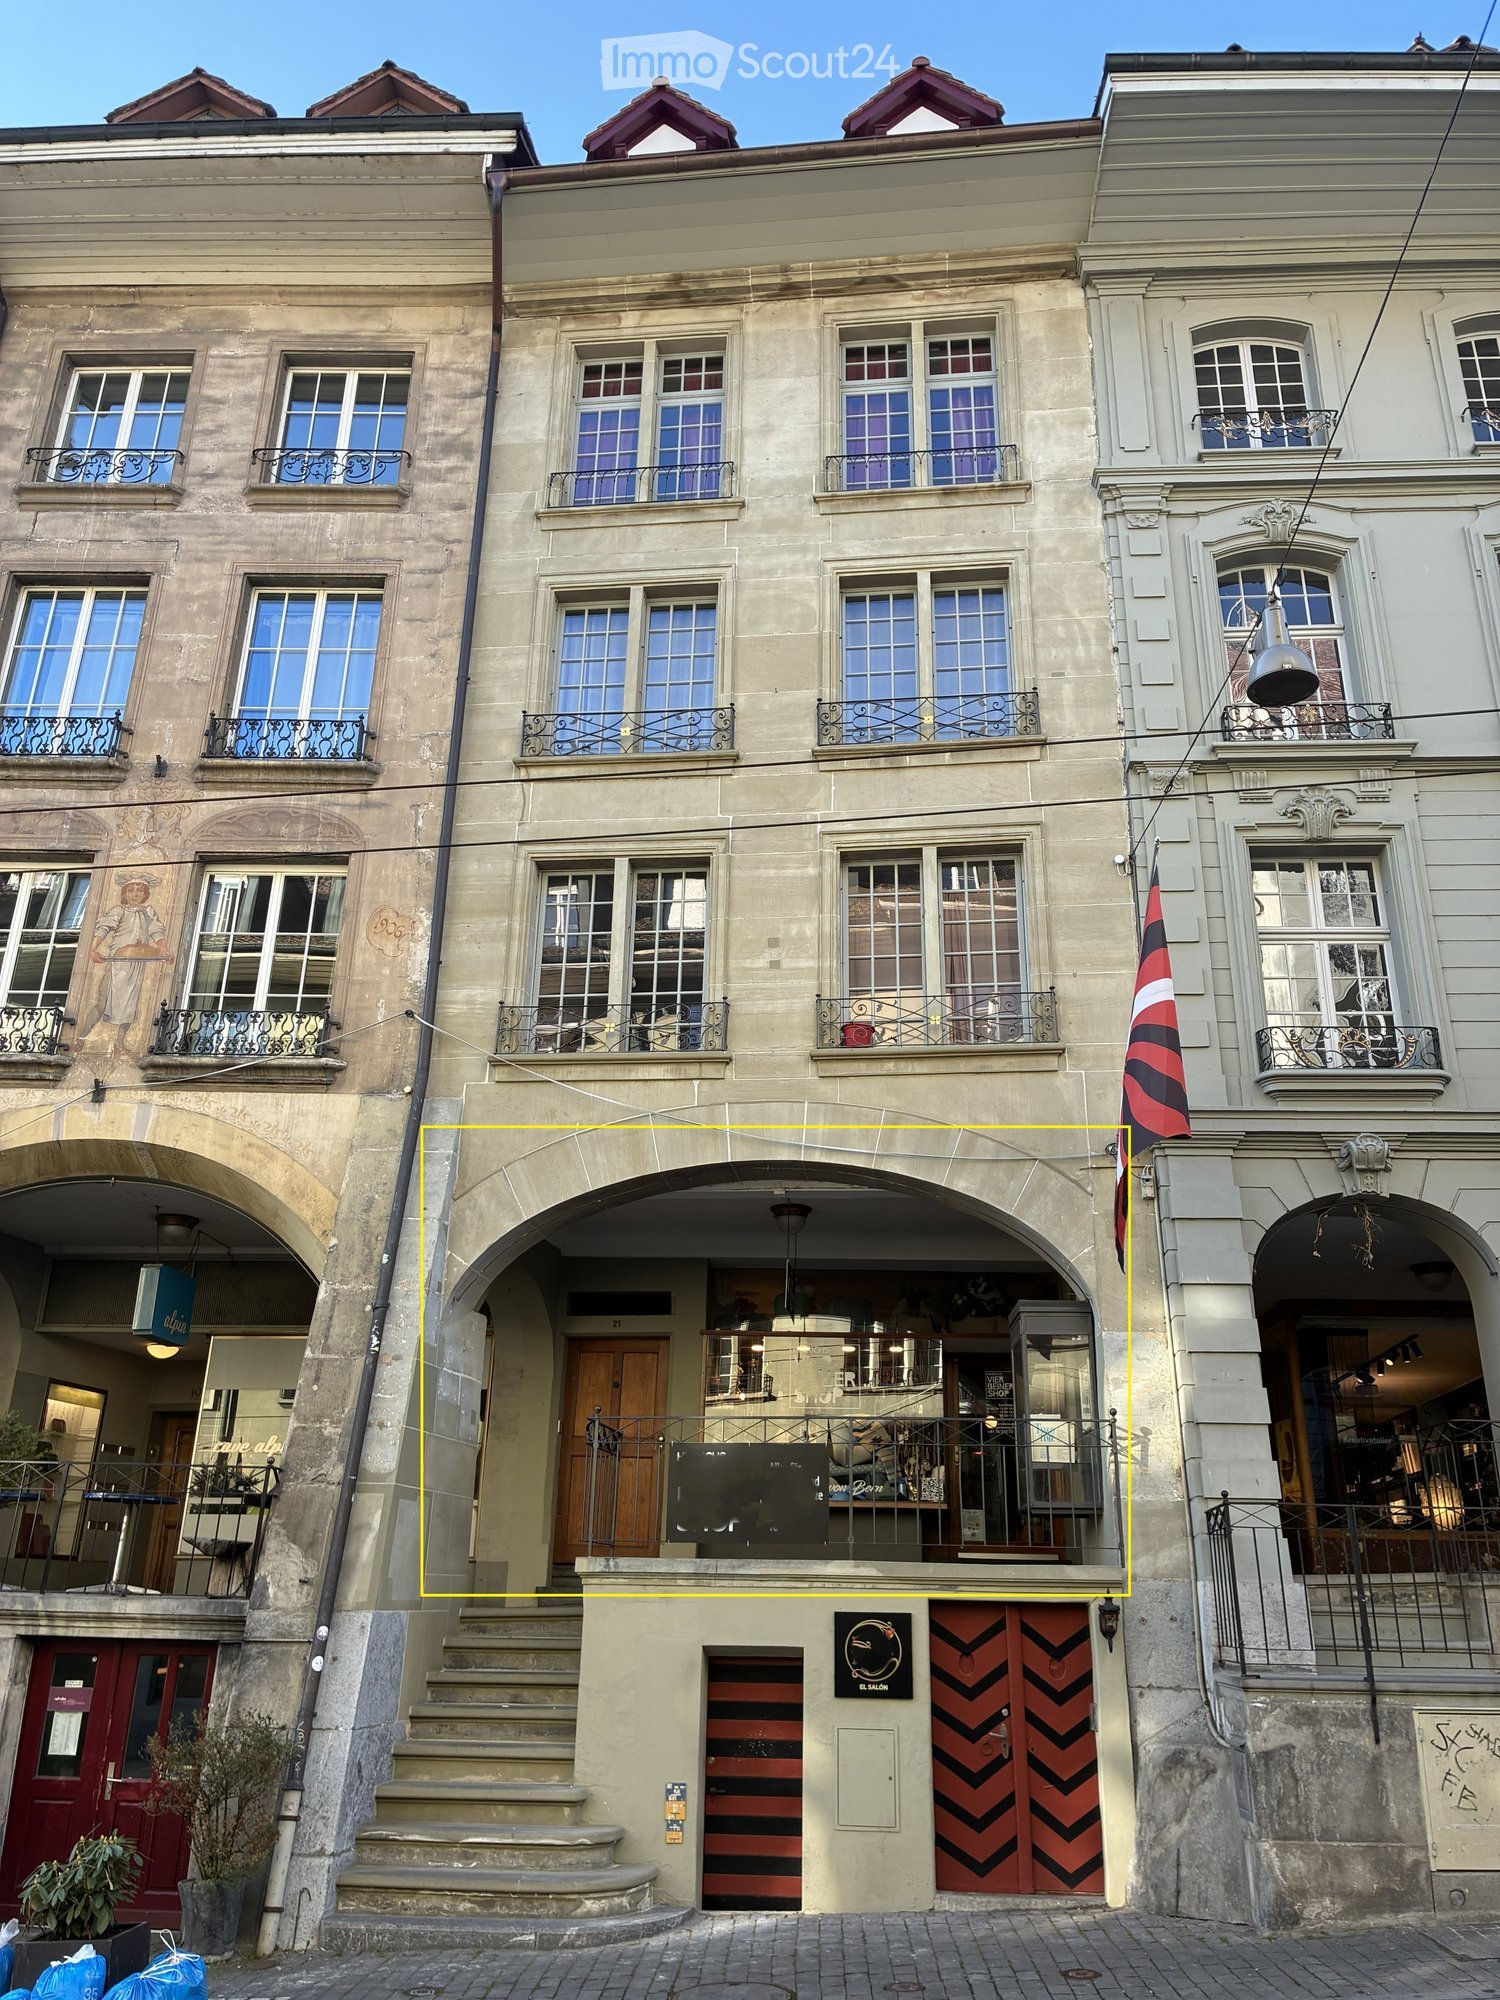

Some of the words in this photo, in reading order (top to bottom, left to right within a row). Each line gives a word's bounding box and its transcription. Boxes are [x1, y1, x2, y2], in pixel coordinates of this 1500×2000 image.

[373, 915, 405, 939] 1906
[164, 1310, 187, 1334] alpin
[612, 1319, 621, 1328] 21
[212, 1441, 251, 1454] cave
[852, 1479, 884, 1496] Bern
